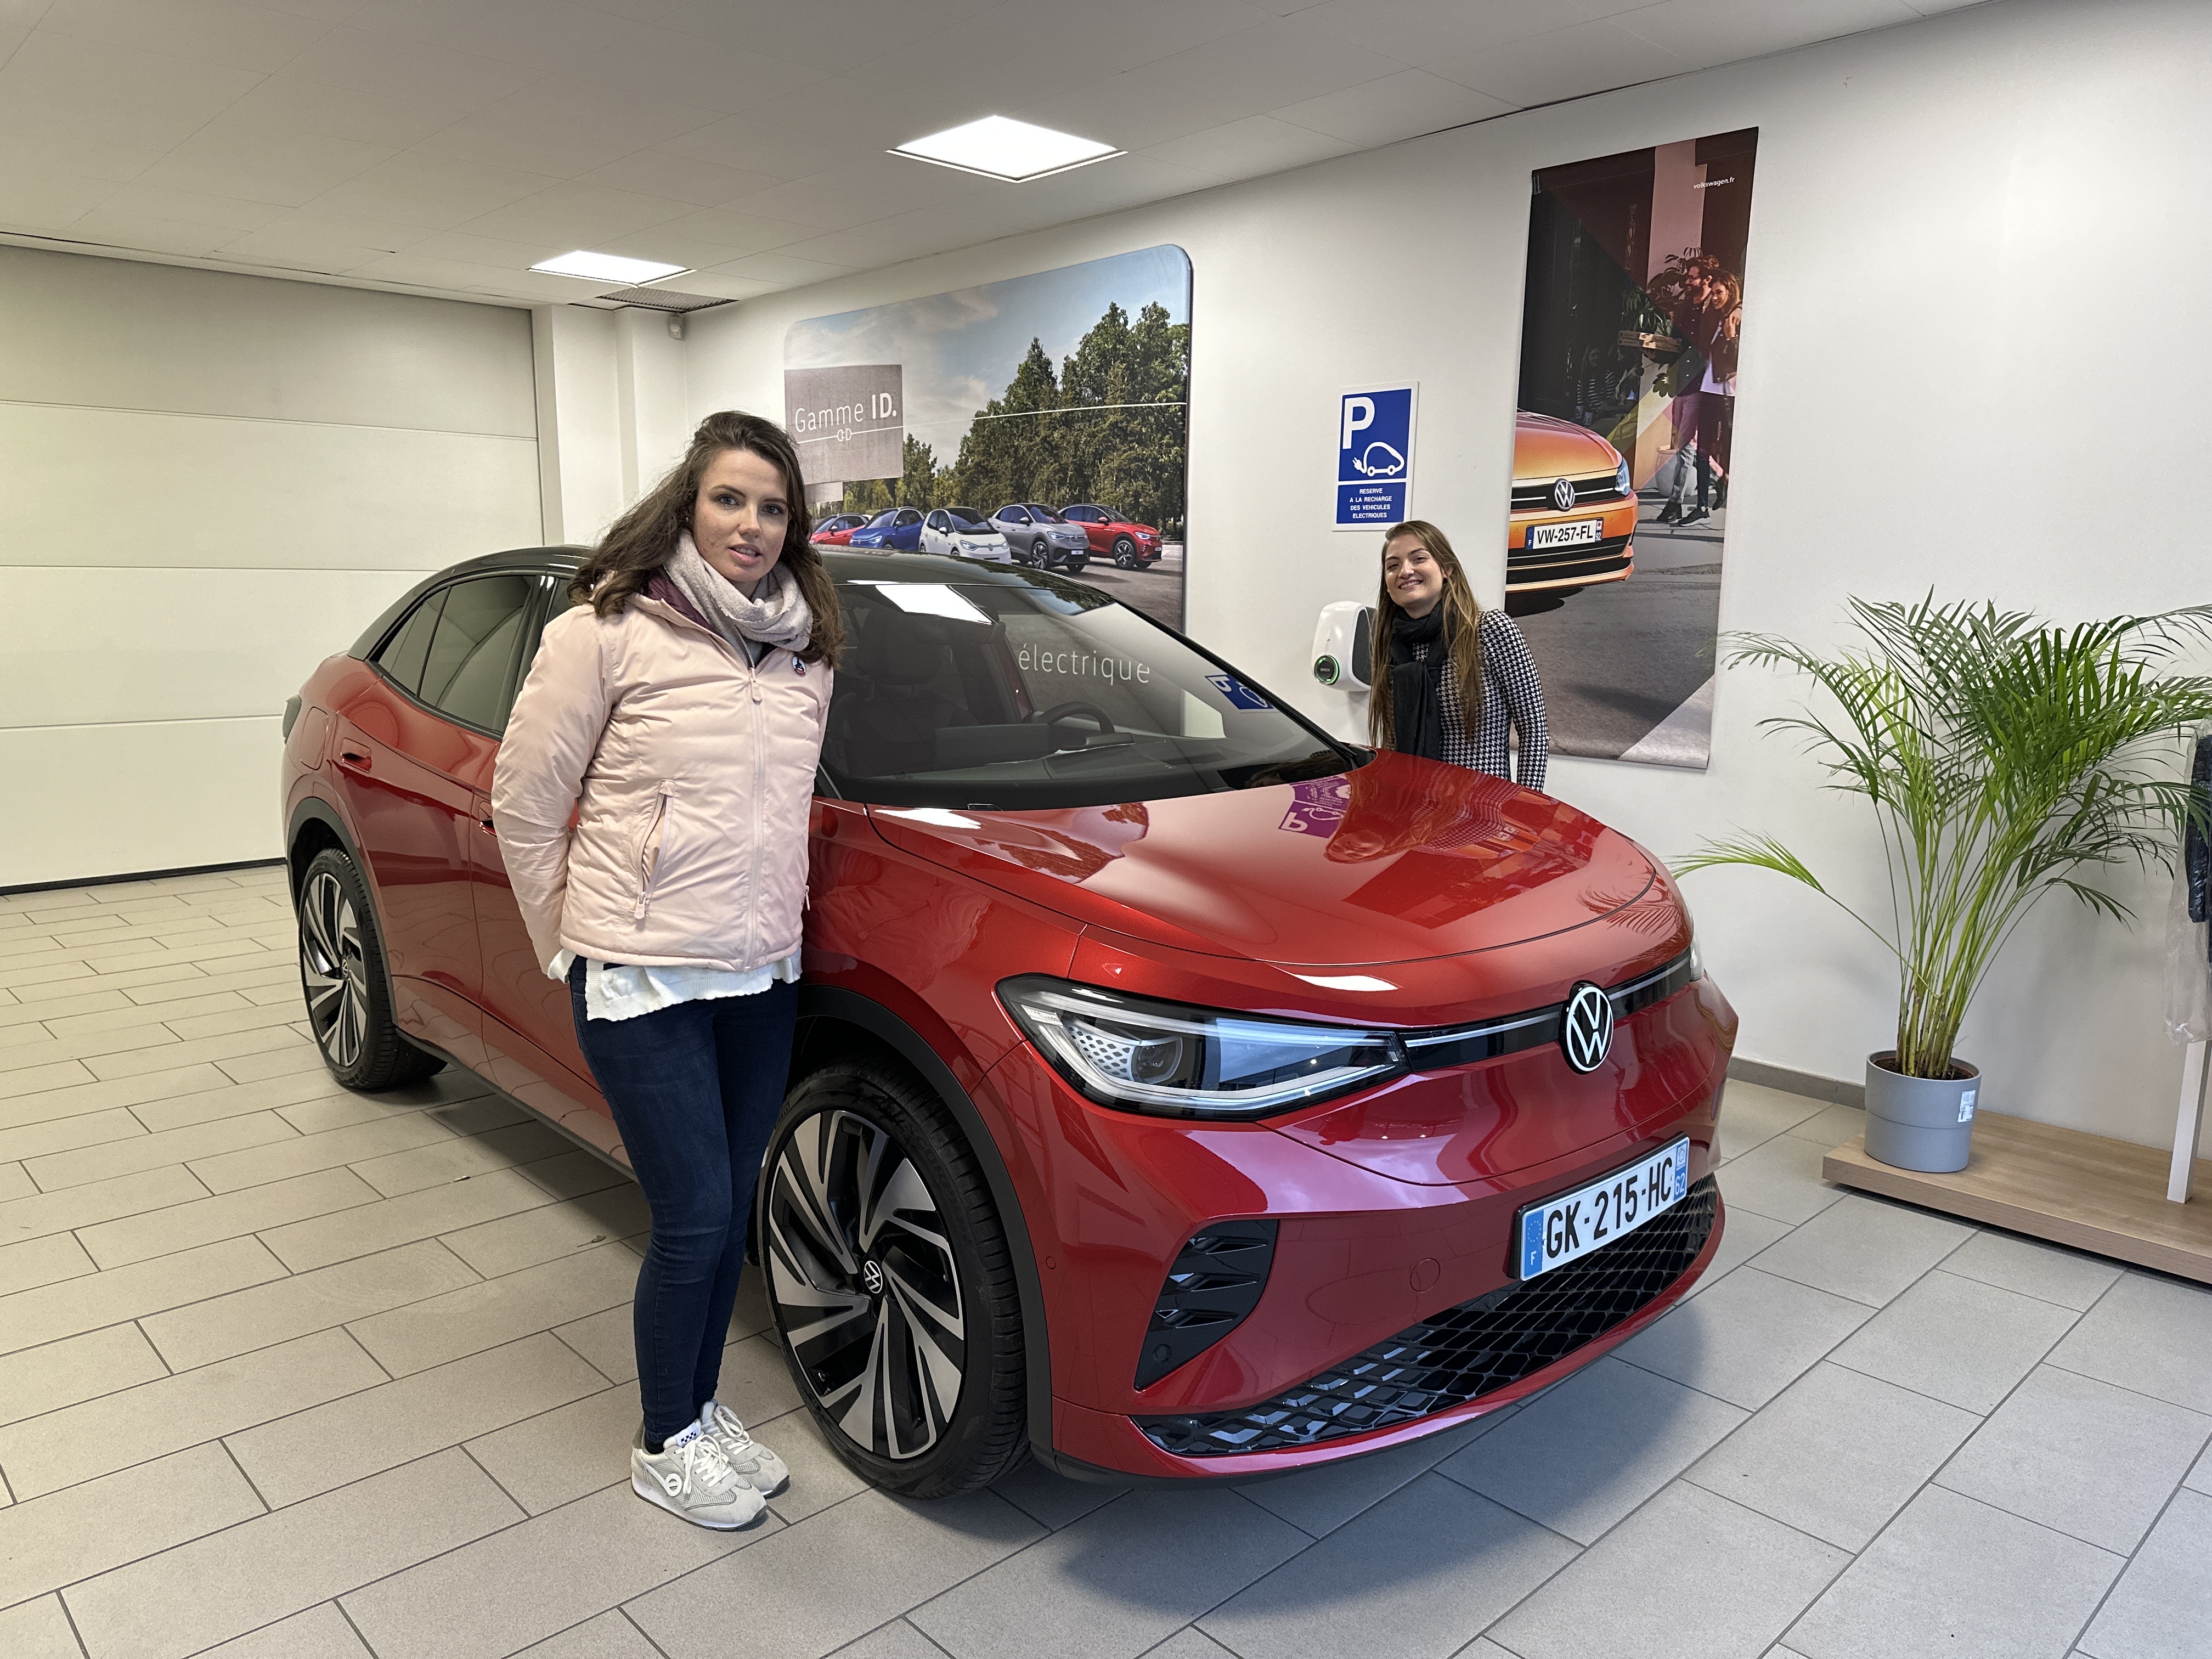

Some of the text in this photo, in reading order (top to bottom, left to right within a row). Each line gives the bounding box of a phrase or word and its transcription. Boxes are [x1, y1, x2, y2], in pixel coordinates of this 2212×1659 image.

[1693, 177, 1735, 189] volkswagen.fr
[795, 393, 897, 432] Gamme ID.
[1342, 397, 1375, 449] P
[1537, 525, 1593, 544] VW-257-FL
[1595, 532, 1601, 541] 92
[1019, 643, 1150, 686] électrique
[1530, 1157, 1685, 1266] F GK-215-HC 62
